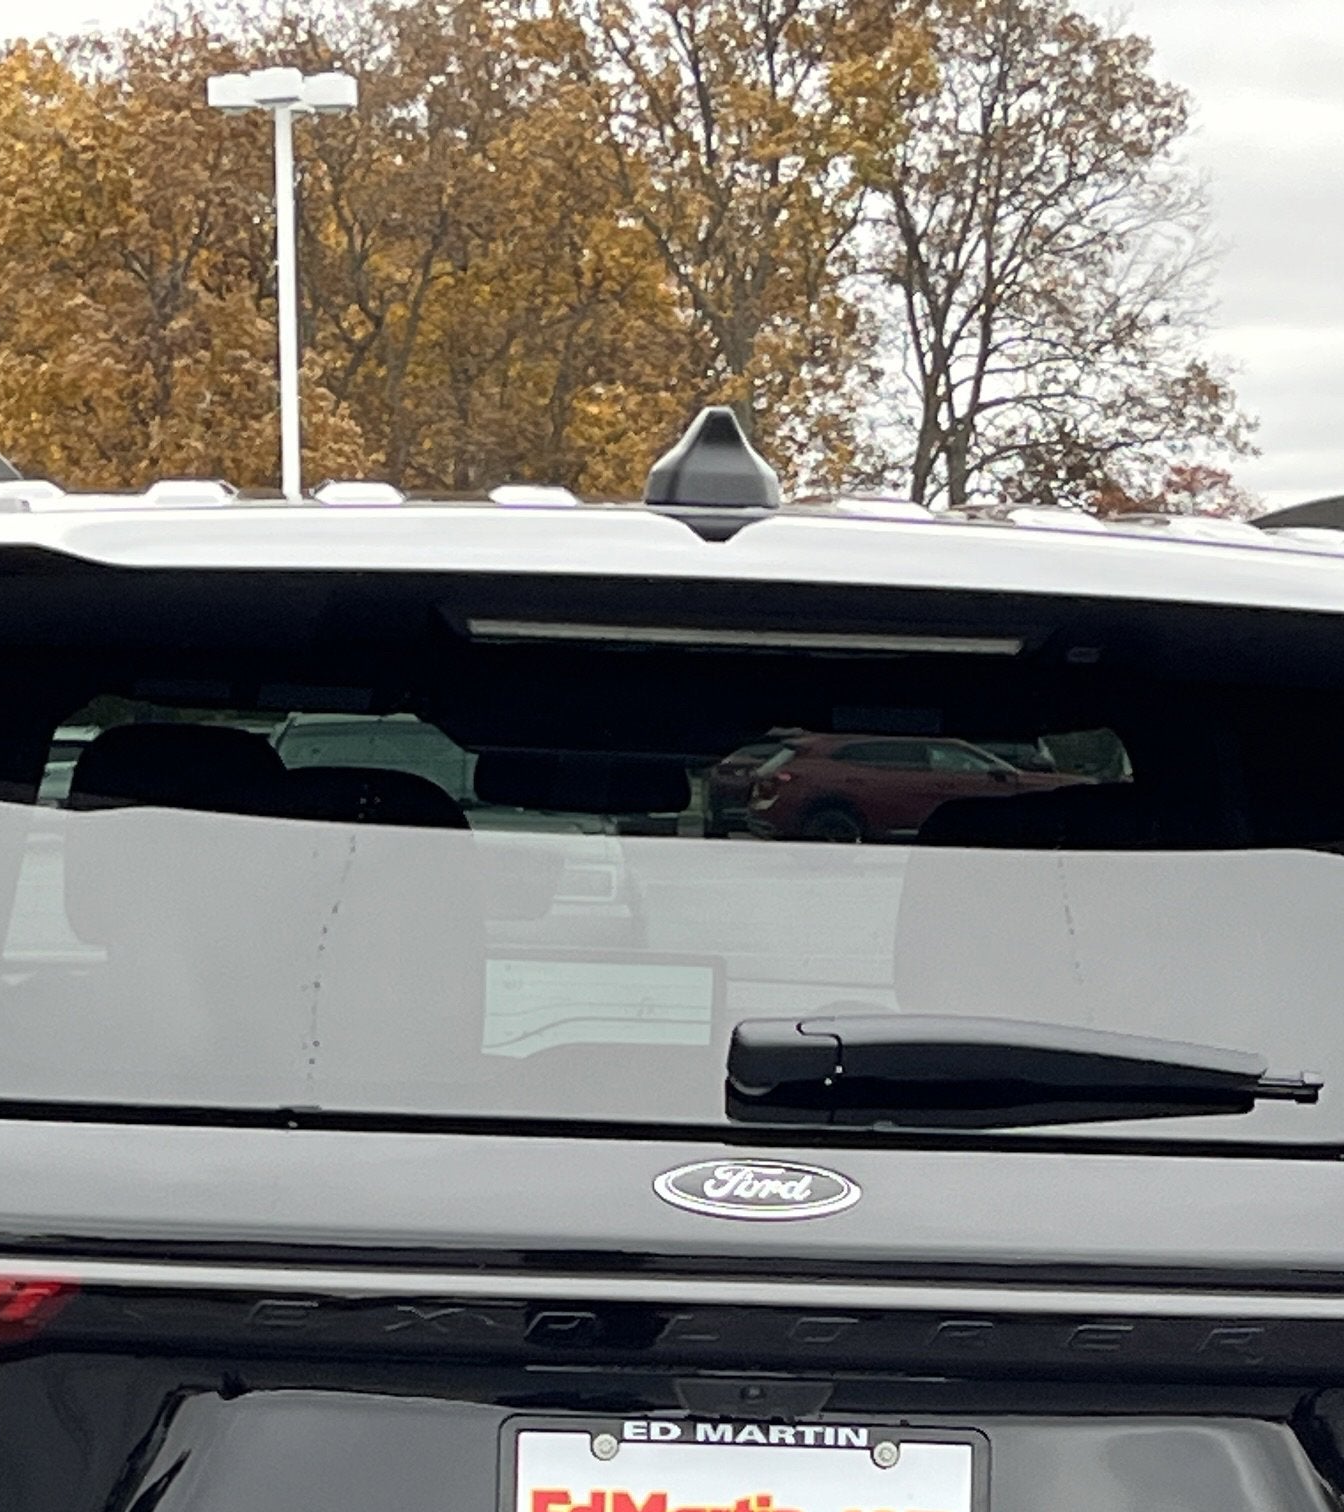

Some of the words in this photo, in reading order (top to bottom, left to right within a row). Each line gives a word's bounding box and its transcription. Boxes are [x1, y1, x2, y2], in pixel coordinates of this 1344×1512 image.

[703, 1165, 812, 1201] Ford
[248, 1299, 1268, 1362] EXPLORER
[622, 1420, 682, 1441] ED
[695, 1423, 870, 1447] MARTIN
